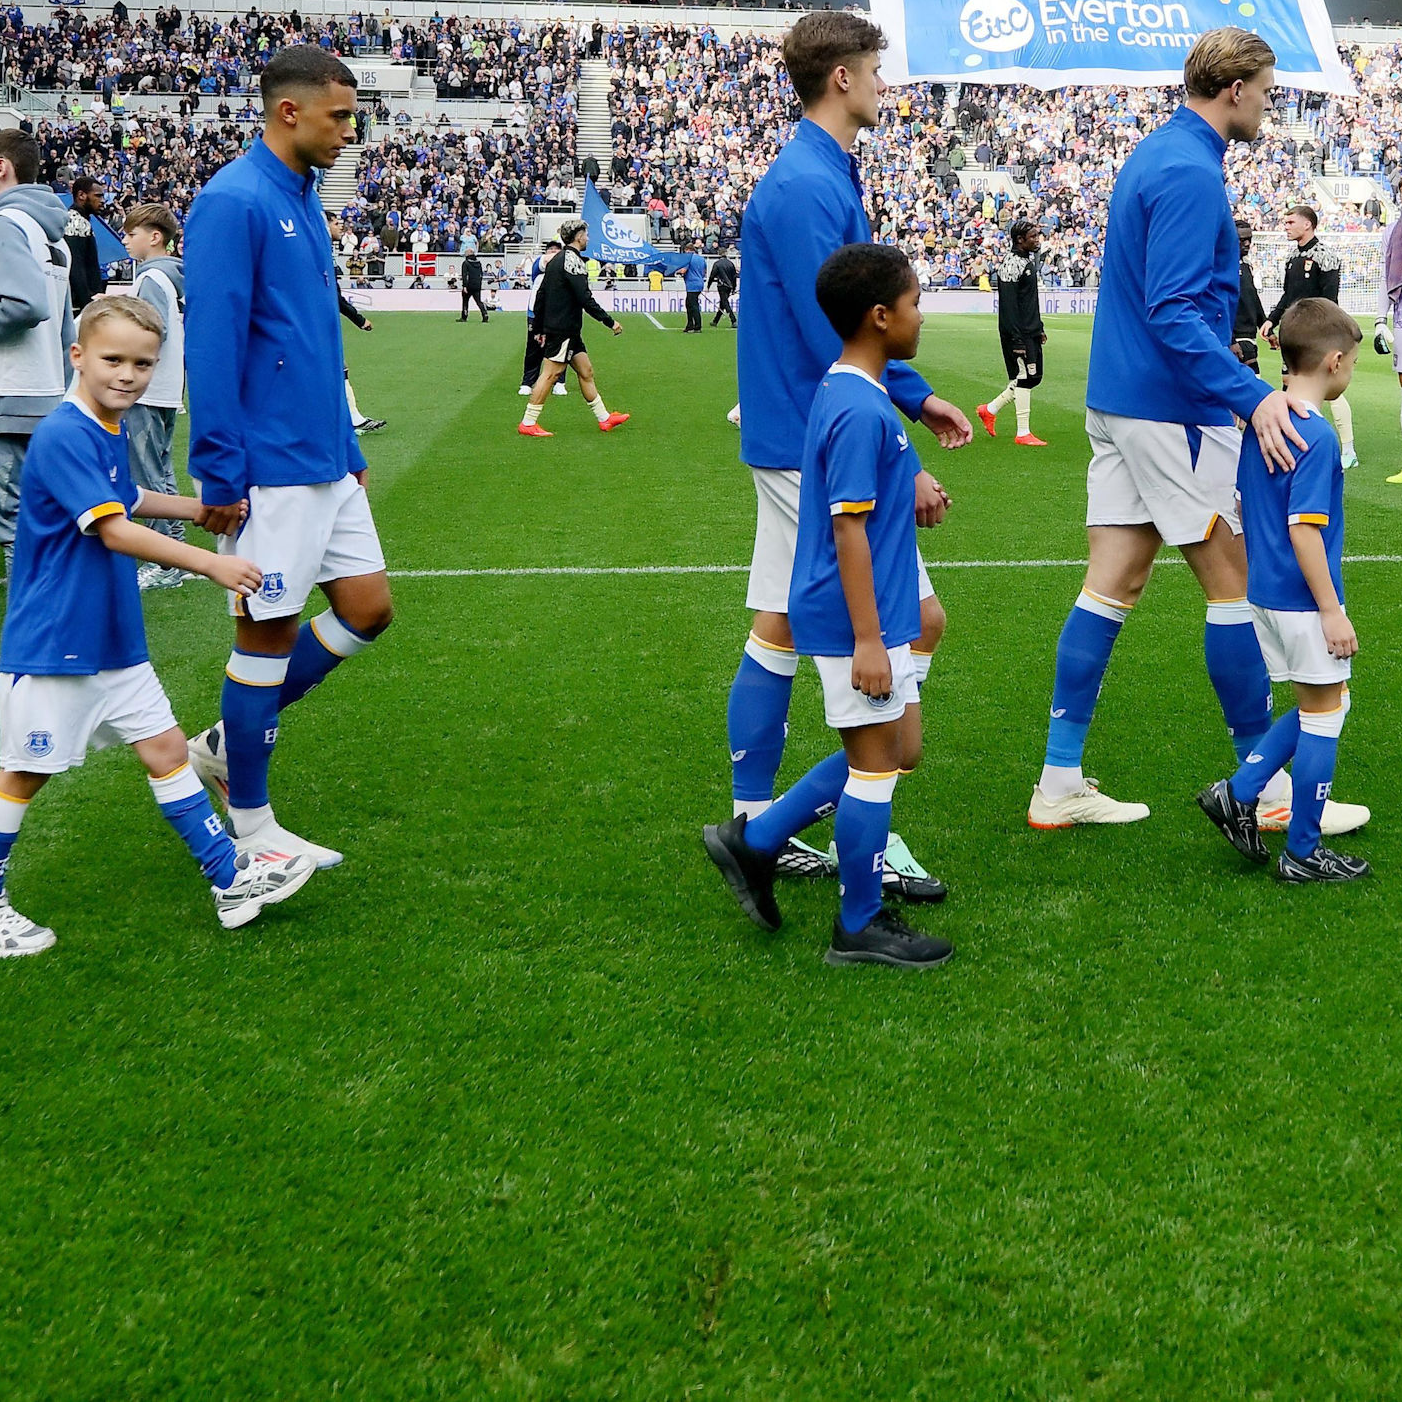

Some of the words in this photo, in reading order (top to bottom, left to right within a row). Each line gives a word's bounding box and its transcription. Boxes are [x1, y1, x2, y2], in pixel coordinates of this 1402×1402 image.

[1045, 26, 1067, 44] in
[1071, 23, 1109, 43] the
[360, 71, 377, 84] 125
[1334, 183, 1350, 196] 019
[600, 243, 651, 259] Everto
[613, 297, 662, 313] SCHOOL
[669, 298, 685, 313] OF
[1045, 299, 1061, 313] OF
